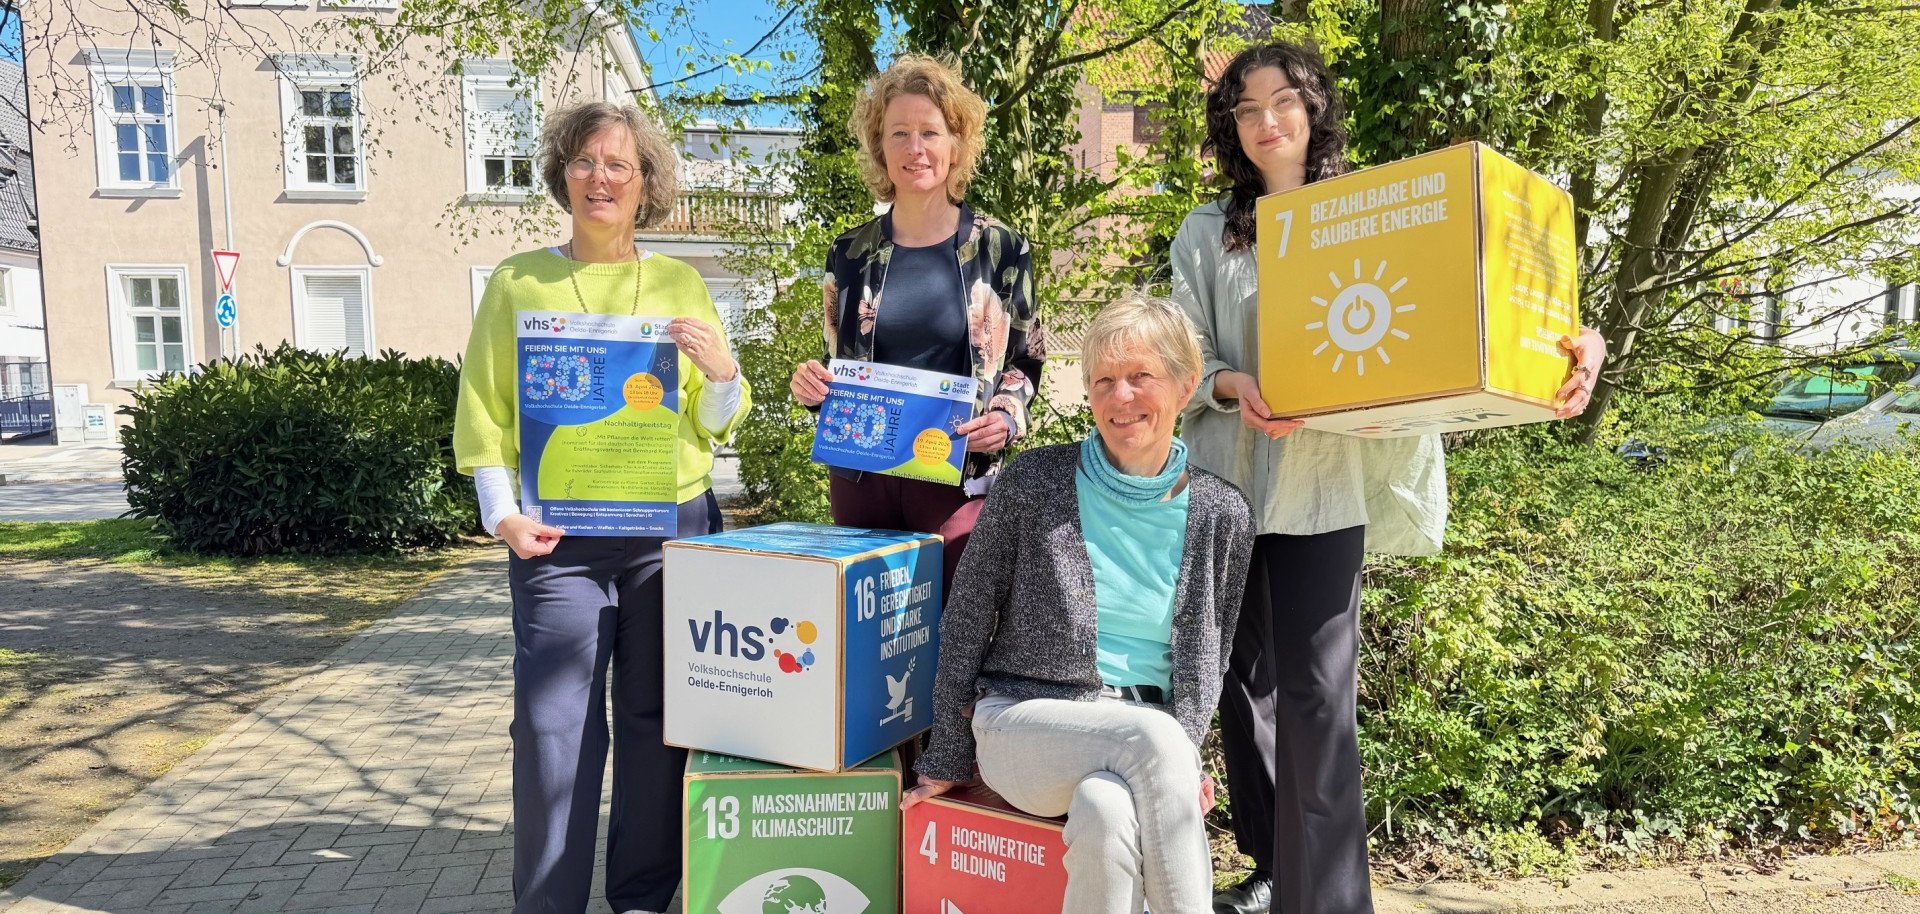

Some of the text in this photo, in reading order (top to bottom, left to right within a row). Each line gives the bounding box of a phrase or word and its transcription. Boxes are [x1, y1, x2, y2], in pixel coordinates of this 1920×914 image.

[1310, 171, 1446, 224] BEZAHLBARE UND
[1275, 209, 1293, 259] 7
[1310, 199, 1448, 250] SAUBERE ENERGIE
[524, 316, 550, 330] vhs
[525, 344, 553, 352] FEIERN
[554, 345, 568, 353] SIE
[586, 346, 607, 354] UNS!
[592, 356, 605, 403] JAHRE
[833, 365, 857, 378] vhs
[952, 381, 970, 390] Stadt
[830, 388, 905, 407] FEIERN SIE MIT UNS!
[952, 388, 970, 396] Oelde
[604, 420, 672, 430] Nachhaltigkeitstag
[884, 408, 902, 454] JAHRE
[880, 566, 912, 591] FRIEDEN,
[854, 575, 876, 622] 16
[880, 580, 932, 615] GERECHTIGKEIT
[688, 610, 766, 662] vhs
[880, 606, 922, 638] UND STARKE
[880, 626, 930, 661] INSTITUTIONEN
[687, 676, 774, 698] Oelde-Ennigerloh
[688, 662, 772, 684] Volkshochschule
[702, 796, 740, 840] 13
[752, 791, 889, 814] MASSNAHMEN ZUM
[752, 816, 854, 838] KLIMASCHUTZ
[919, 820, 939, 866] 4
[950, 825, 1046, 867] HOCHWERTIGE
[950, 850, 1006, 883] BILDUNG
